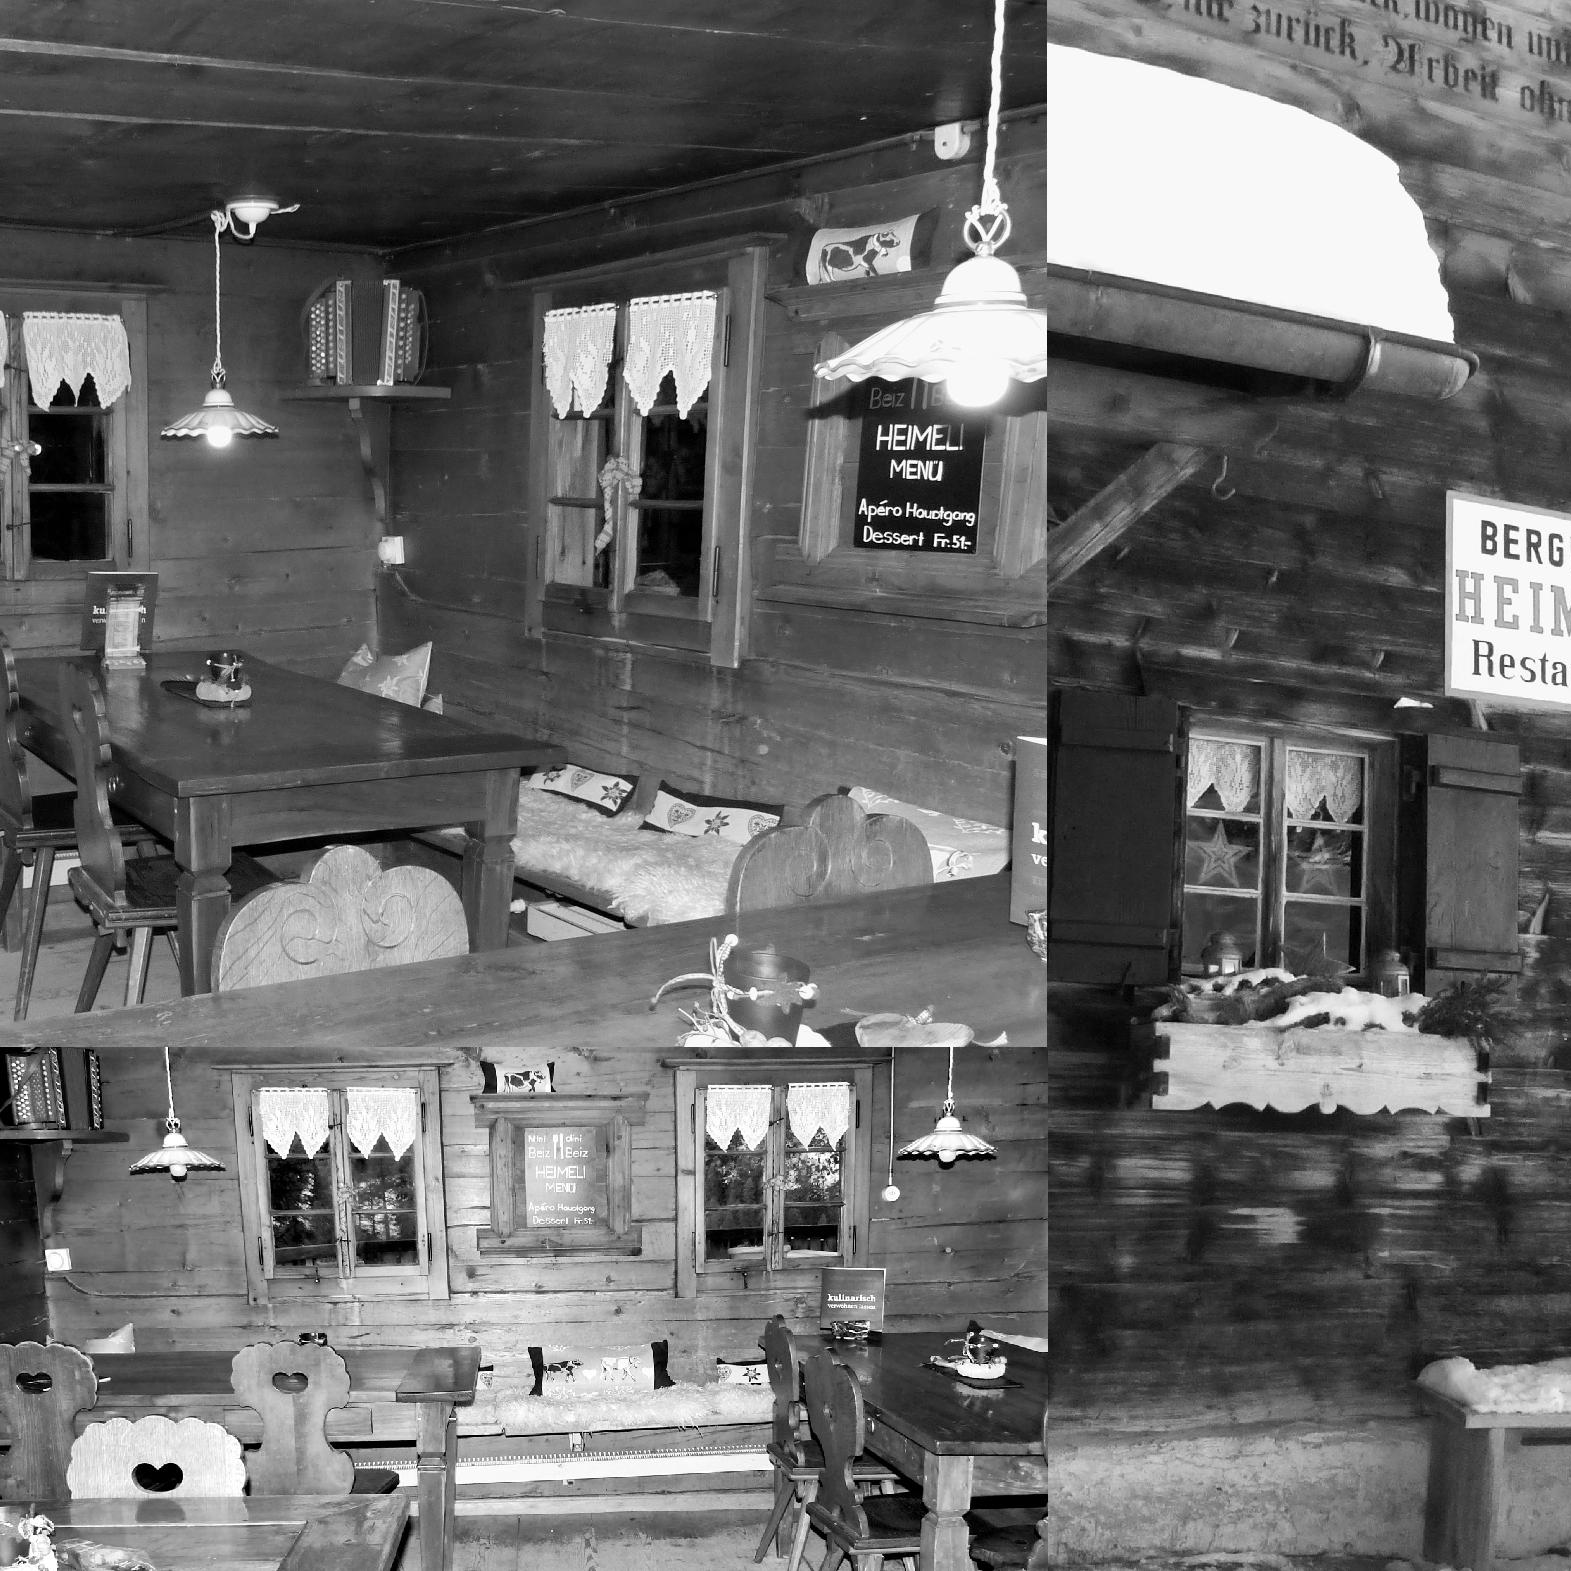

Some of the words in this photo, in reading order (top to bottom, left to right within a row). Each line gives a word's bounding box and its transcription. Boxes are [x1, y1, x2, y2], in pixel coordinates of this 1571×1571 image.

[889, 459, 943, 481] MENÜ
[858, 498, 903, 523] Apéro
[862, 525, 924, 547] Dessert
[535, 1165, 586, 1179] HEIMELI
